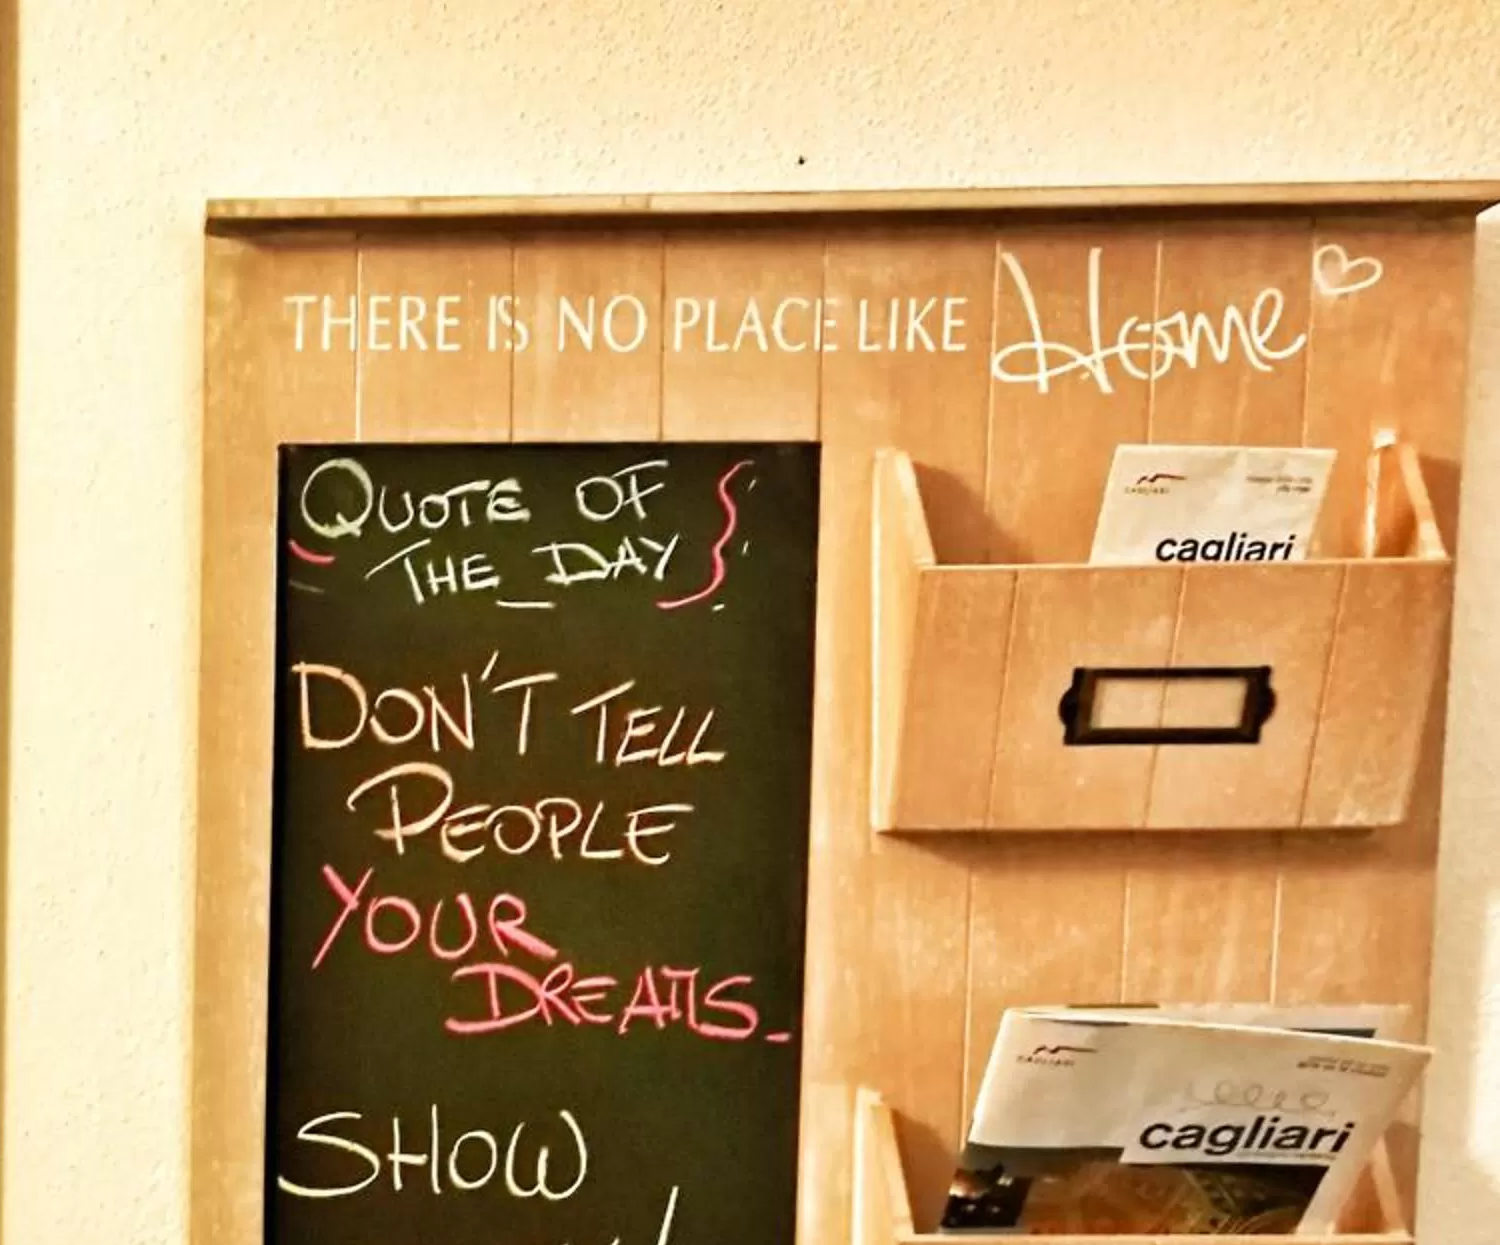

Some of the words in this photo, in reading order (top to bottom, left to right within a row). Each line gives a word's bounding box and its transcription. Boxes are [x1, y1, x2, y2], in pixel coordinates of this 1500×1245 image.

[284, 294, 461, 352] THERE
[487, 294, 529, 353] IS
[558, 294, 647, 353] NO
[673, 295, 837, 354] PLACE
[857, 296, 968, 353] LIKE
[991, 247, 1307, 394] Home
[301, 458, 530, 538] QUOTE
[575, 459, 669, 520] OF
[364, 538, 500, 605] THE
[532, 533, 681, 585] DAY
[291, 651, 558, 756] DON'T
[571, 680, 728, 767] TELL
[347, 762, 695, 866] PEOPLE
[311, 863, 559, 970] YOUR
[277, 1103, 588, 1200] SHOW
[1138, 1115, 1356, 1157] cagliari
